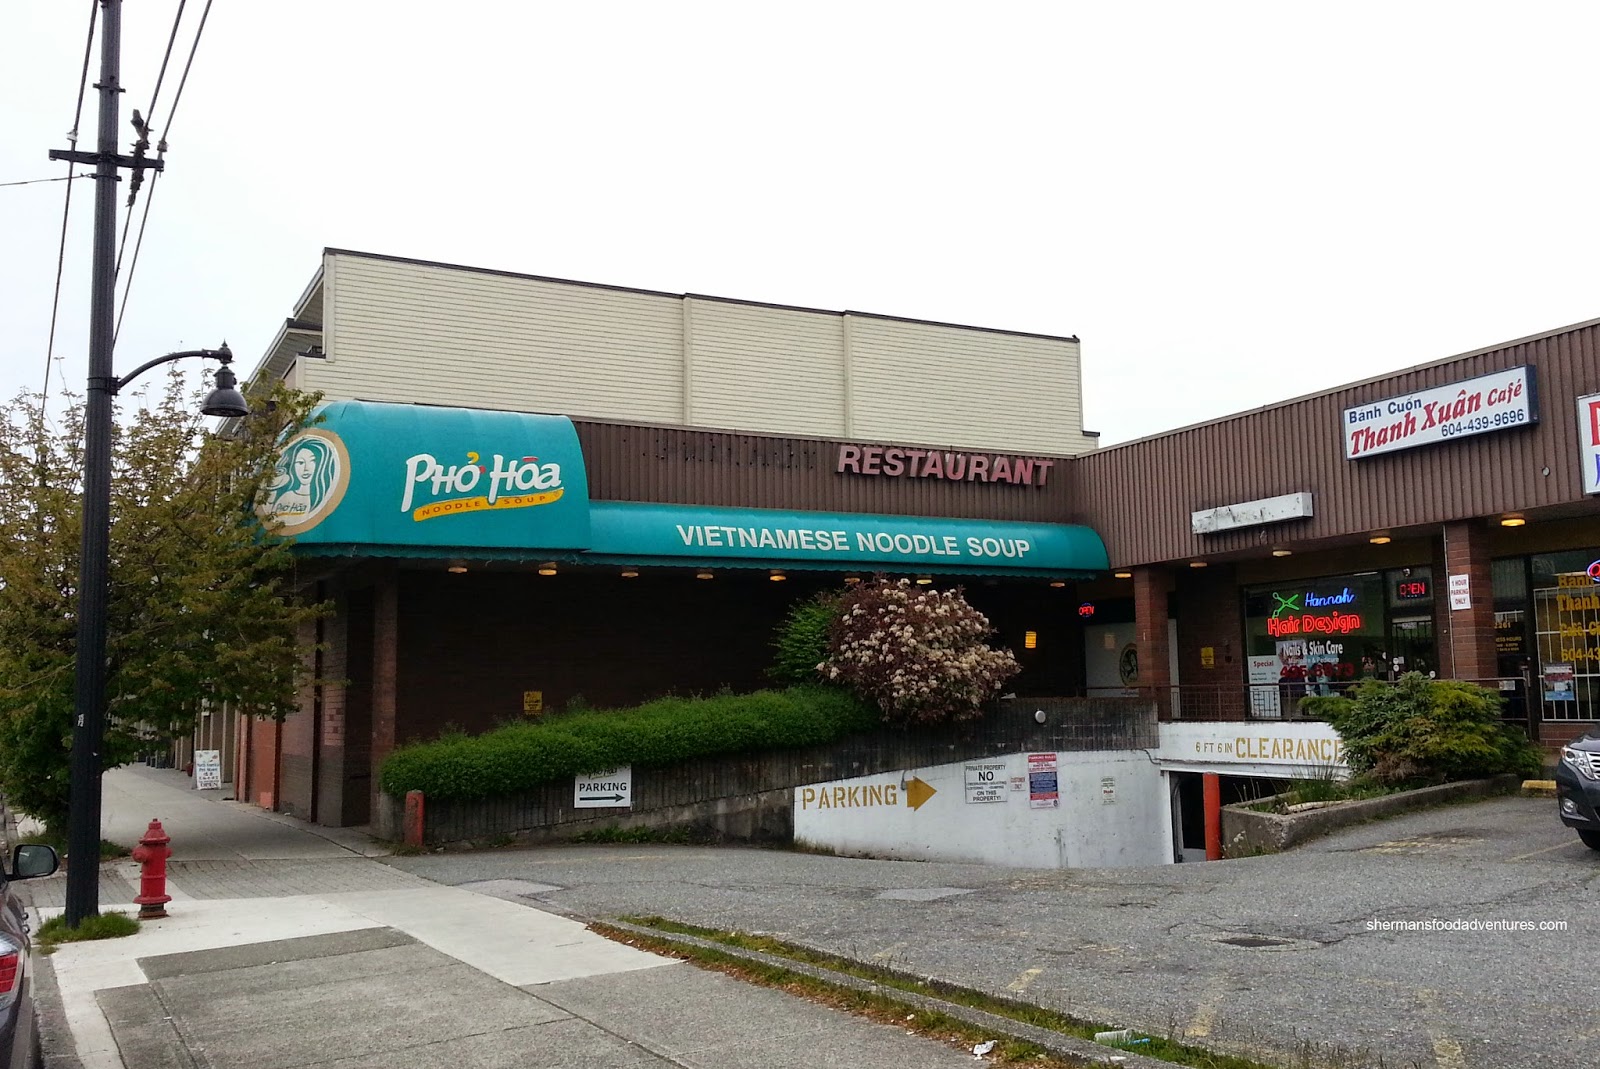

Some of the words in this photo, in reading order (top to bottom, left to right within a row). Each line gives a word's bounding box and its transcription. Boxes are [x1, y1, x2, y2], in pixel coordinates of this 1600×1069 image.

[1351, 411, 1417, 455] Thanh
[1421, 389, 1481, 431] Xuân
[1487, 378, 1523, 407] Café
[1441, 409, 1525, 437] 604-439-9696
[837, 444, 1054, 487] RESTAURANT
[421, 500, 481, 517] NOODLE
[503, 495, 546, 505] SOUP
[676, 524, 850, 552] VIETNAMESE
[856, 532, 961, 556] NOODLE
[967, 536, 1030, 558] SOUP
[1304, 587, 1355, 607] Hannah
[1400, 582, 1425, 595] OPEN
[1450, 588, 1469, 596] PARKING
[1078, 606, 1095, 616] OPEN
[1557, 593, 1600, 611] Thanh
[1267, 615, 1301, 638] Hair
[1302, 611, 1361, 634] Design
[1283, 641, 1301, 656] Nails
[1302, 642, 1308, 656] &
[1309, 640, 1325, 655] Skin
[1326, 640, 1344, 655] Care
[1253, 661, 1274, 669] Special
[1195, 741, 1201, 753] 6
[1203, 742, 1215, 753] FT
[1217, 742, 1223, 753] 6
[1224, 742, 1233, 753] IN
[1235, 737, 1345, 761] CLEARANCE
[978, 771, 994, 781] NO
[579, 782, 627, 792] PARKING
[802, 784, 898, 810] PARKING
